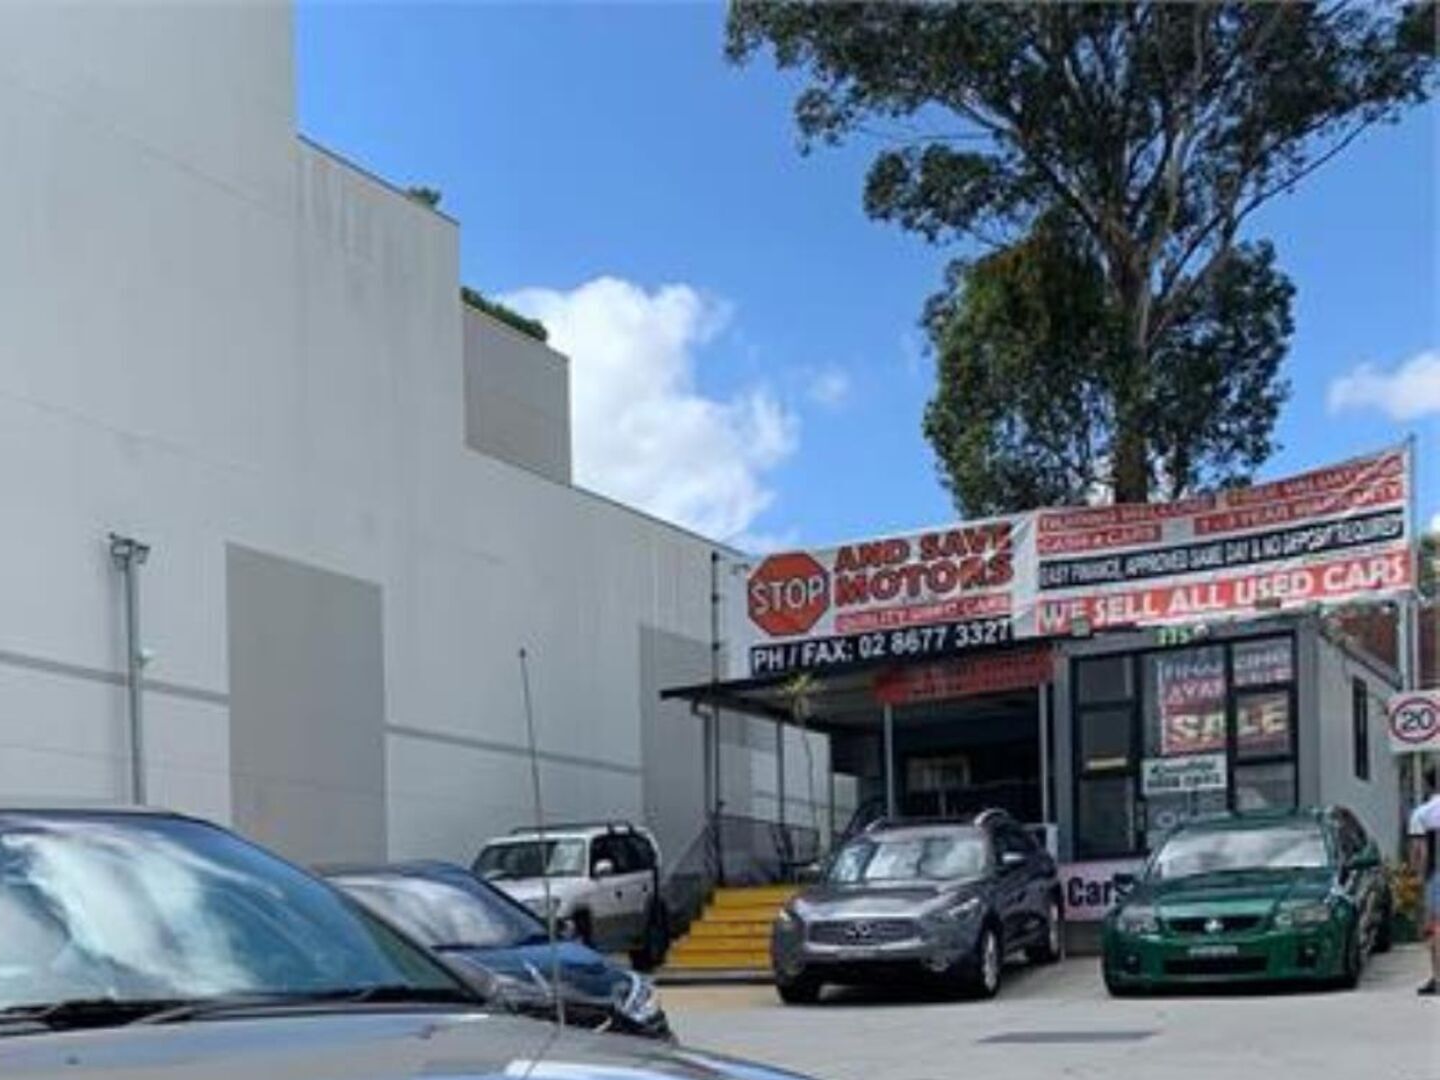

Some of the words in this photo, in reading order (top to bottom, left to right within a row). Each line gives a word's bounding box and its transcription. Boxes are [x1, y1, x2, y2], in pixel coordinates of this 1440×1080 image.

[834, 540, 909, 572] AND
[920, 525, 1013, 561] SAVE
[751, 574, 823, 616] STOP
[834, 552, 1014, 607] MOTORS
[1041, 603, 1088, 633] WE
[1094, 593, 1160, 620] SELL
[1168, 583, 1229, 612] ALL
[1236, 571, 1311, 604] USED
[1323, 556, 1404, 590] CARS
[755, 646, 785, 672] PH
[801, 642, 853, 665] FAX:
[859, 632, 886, 659] 02
[1402, 708, 1435, 731] 20
